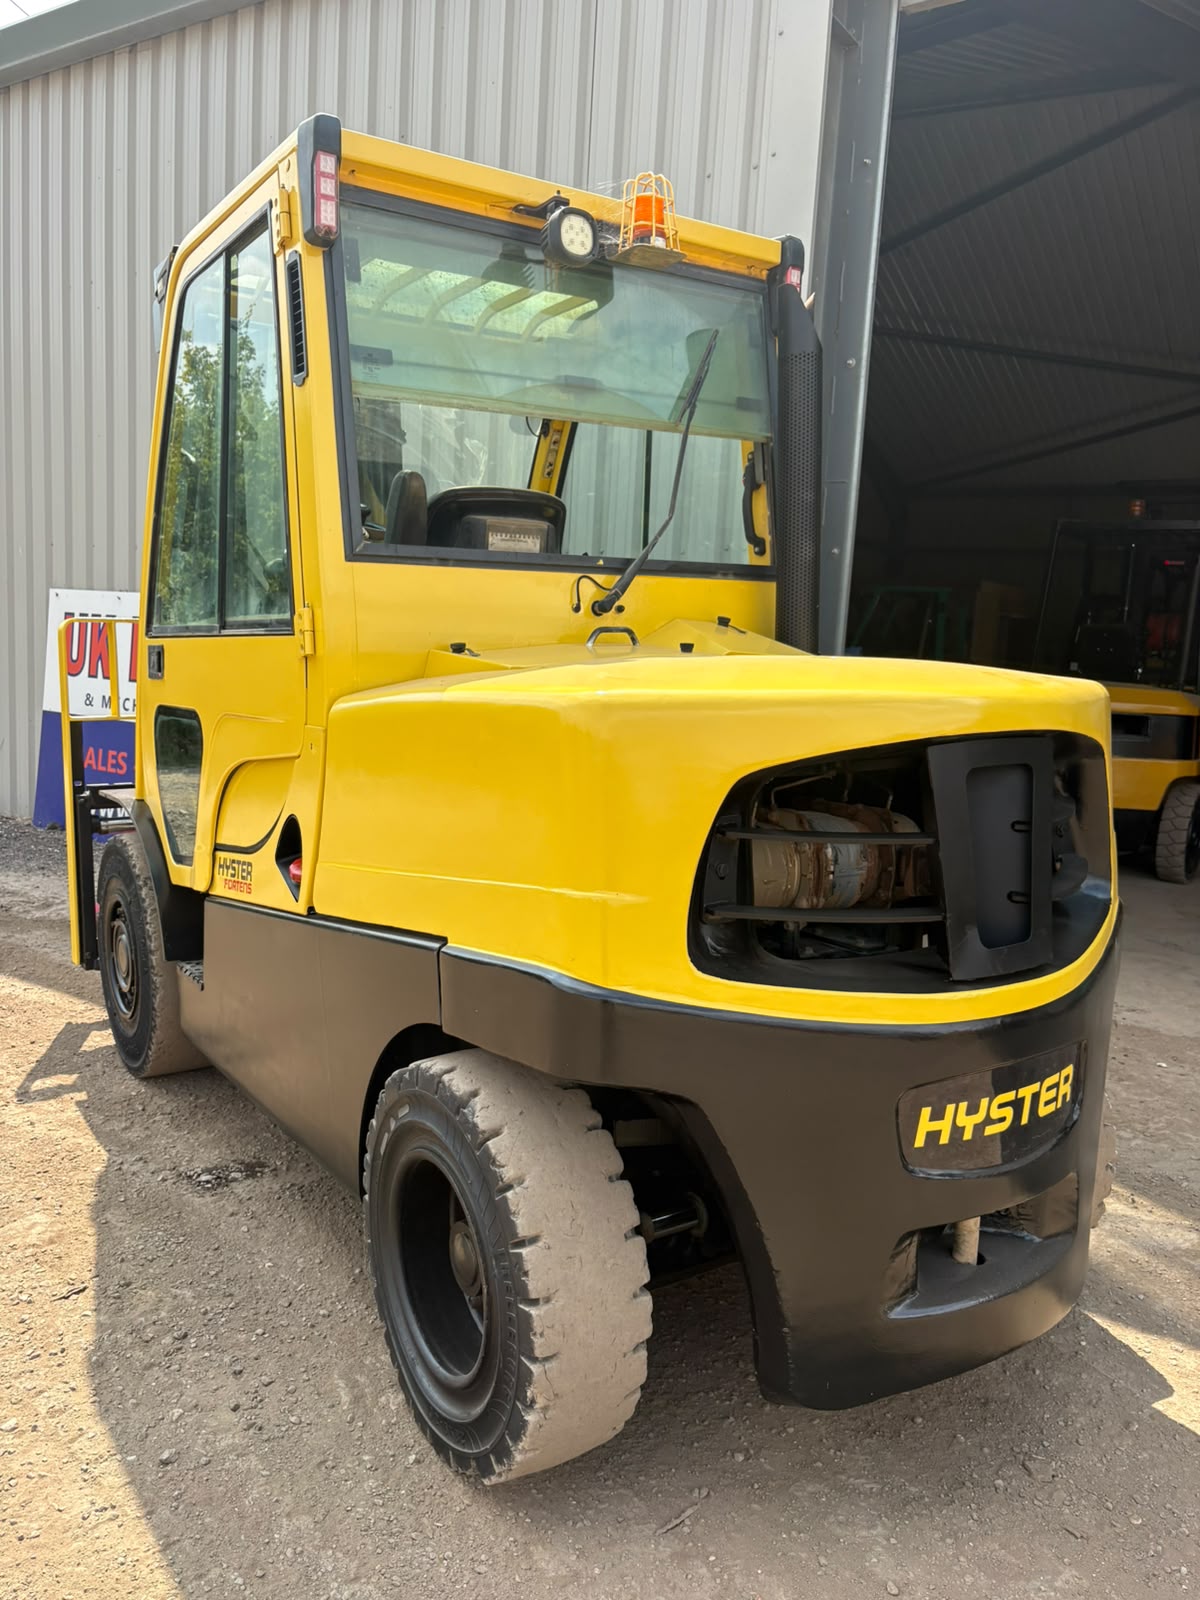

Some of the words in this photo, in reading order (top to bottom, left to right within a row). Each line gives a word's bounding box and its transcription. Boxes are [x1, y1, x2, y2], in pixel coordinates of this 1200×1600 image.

[64, 612, 117, 681] UK
[83, 746, 128, 776] ALES
[217, 856, 253, 882] HYSTER
[223, 878, 253, 894] FORTENS
[913, 1064, 1074, 1149] HYSTER
